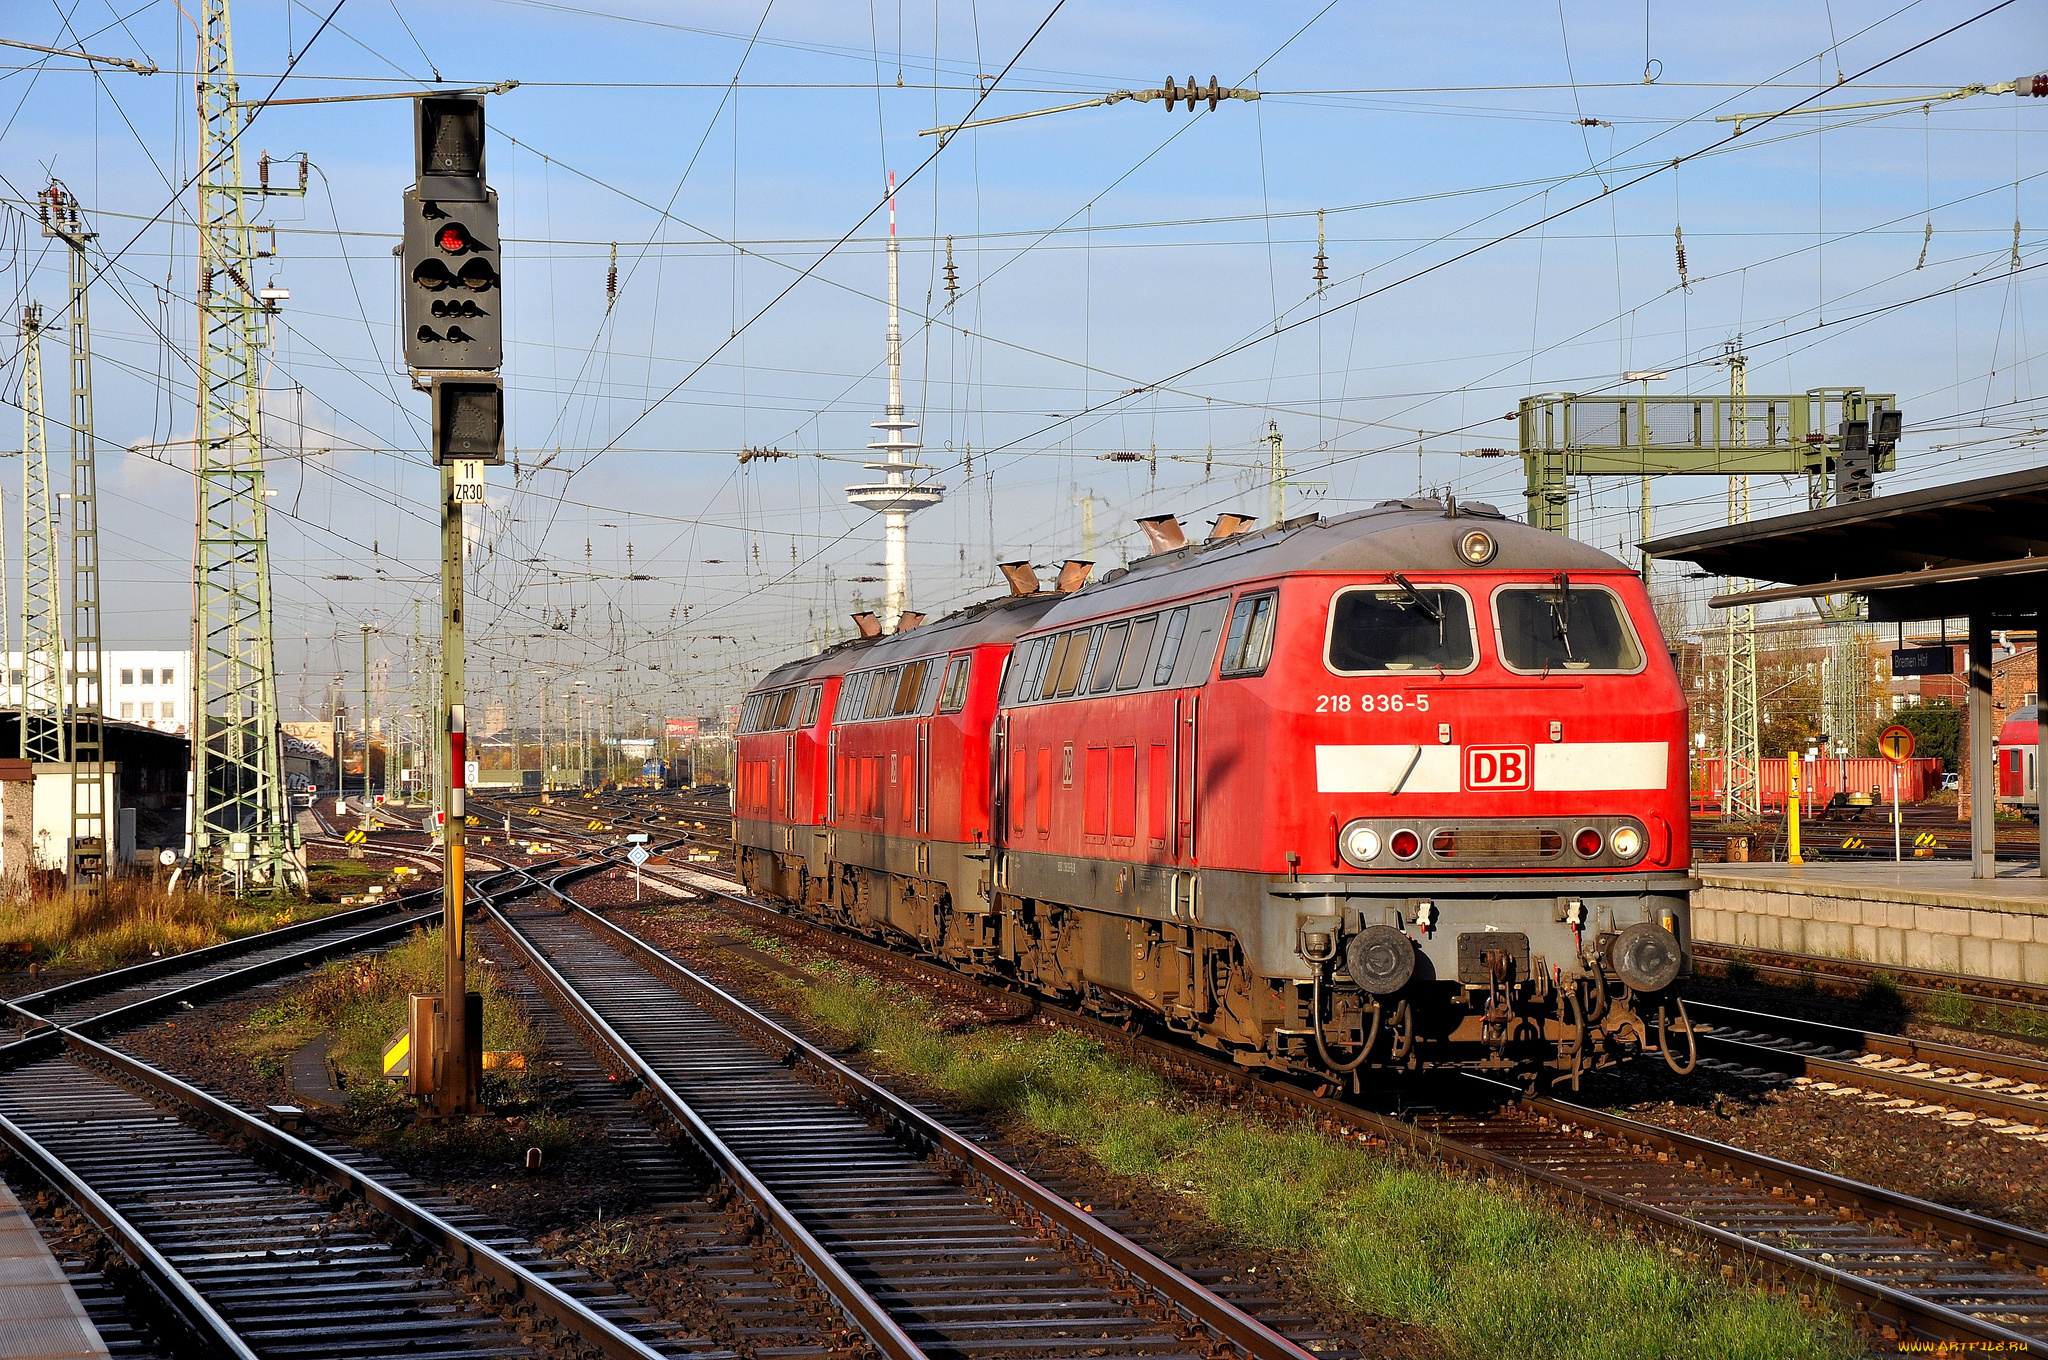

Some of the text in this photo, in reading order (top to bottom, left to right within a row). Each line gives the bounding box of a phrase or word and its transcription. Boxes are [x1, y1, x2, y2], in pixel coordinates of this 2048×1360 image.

[463, 462, 474, 479] 11
[455, 484, 483, 500] ZR30
[1894, 652, 1928, 668] Bremen Hbf
[1315, 694, 1430, 713] 218 836-5
[1474, 752, 1523, 784] DB
